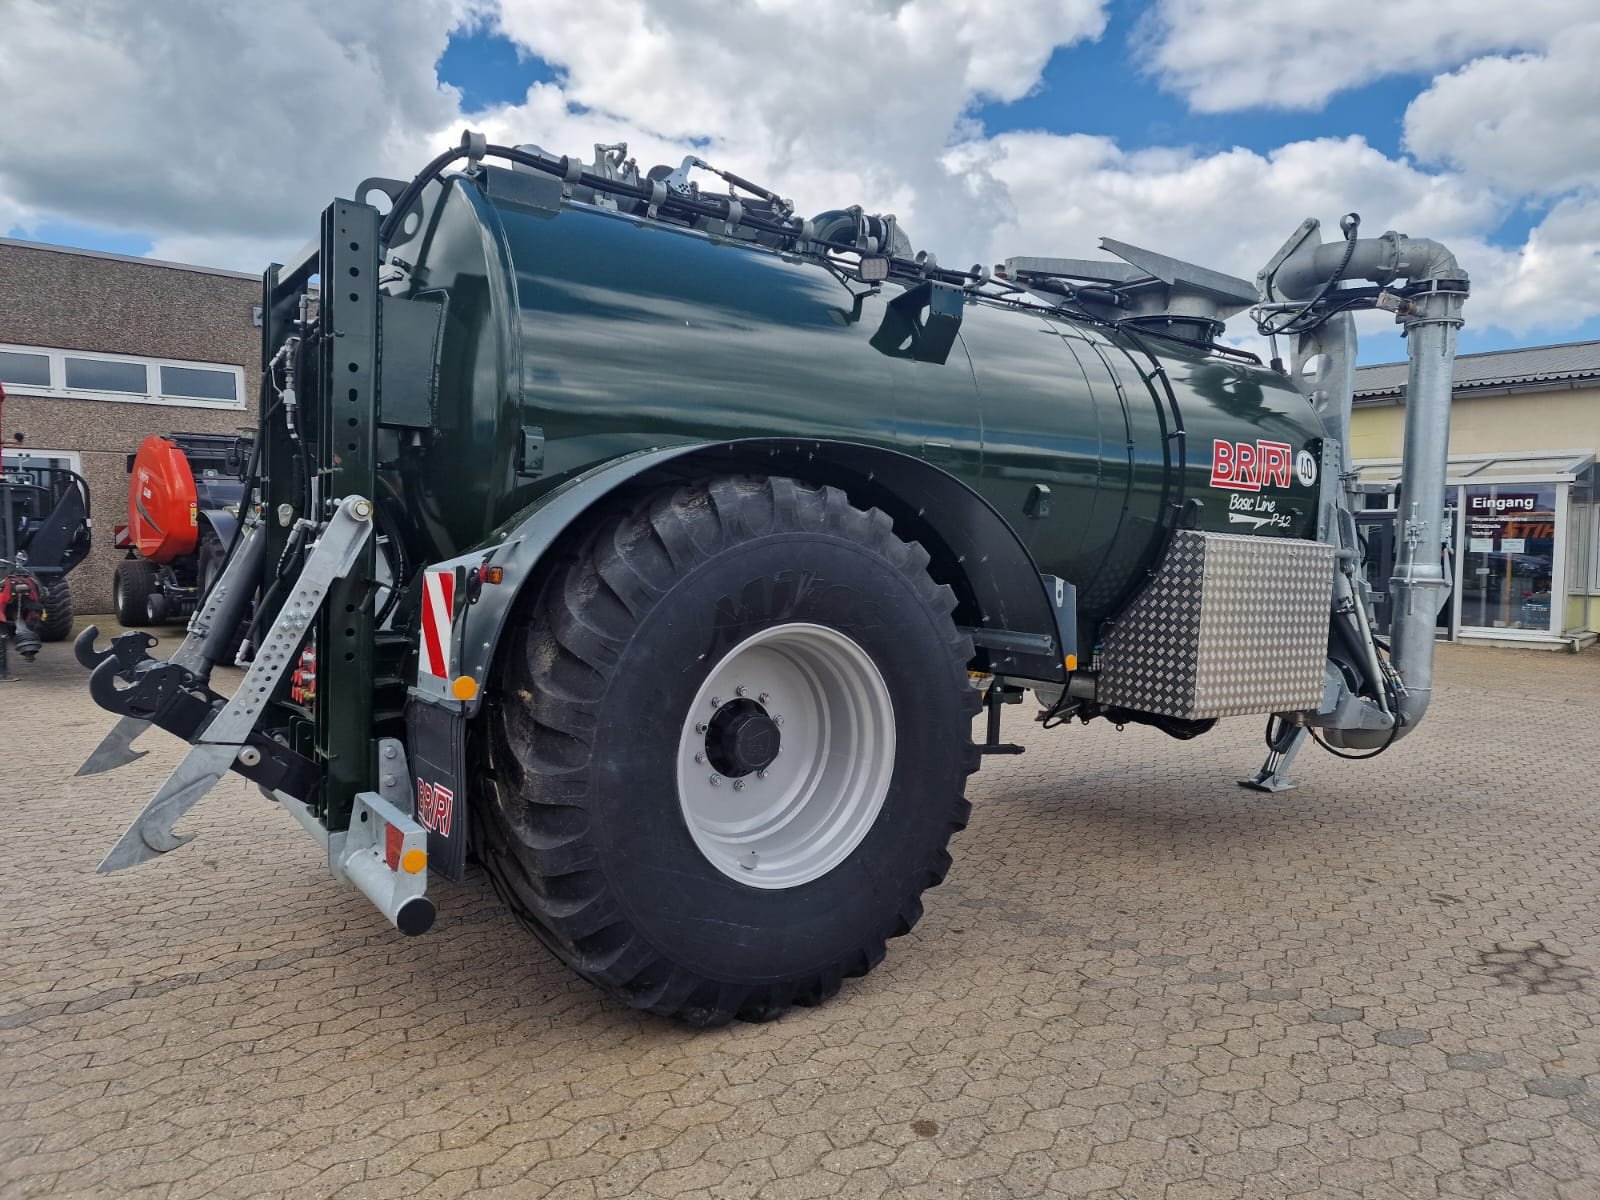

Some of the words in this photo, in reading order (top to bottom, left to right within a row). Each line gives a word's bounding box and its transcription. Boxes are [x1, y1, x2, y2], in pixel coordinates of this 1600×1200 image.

[1210, 439, 1292, 492] BRIRI
[1300, 455, 1313, 480] 40
[1229, 493, 1254, 511] Basic
[1255, 495, 1276, 513] Line
[1472, 497, 1534, 511] Eingang
[417, 777, 454, 838] BRIRI
